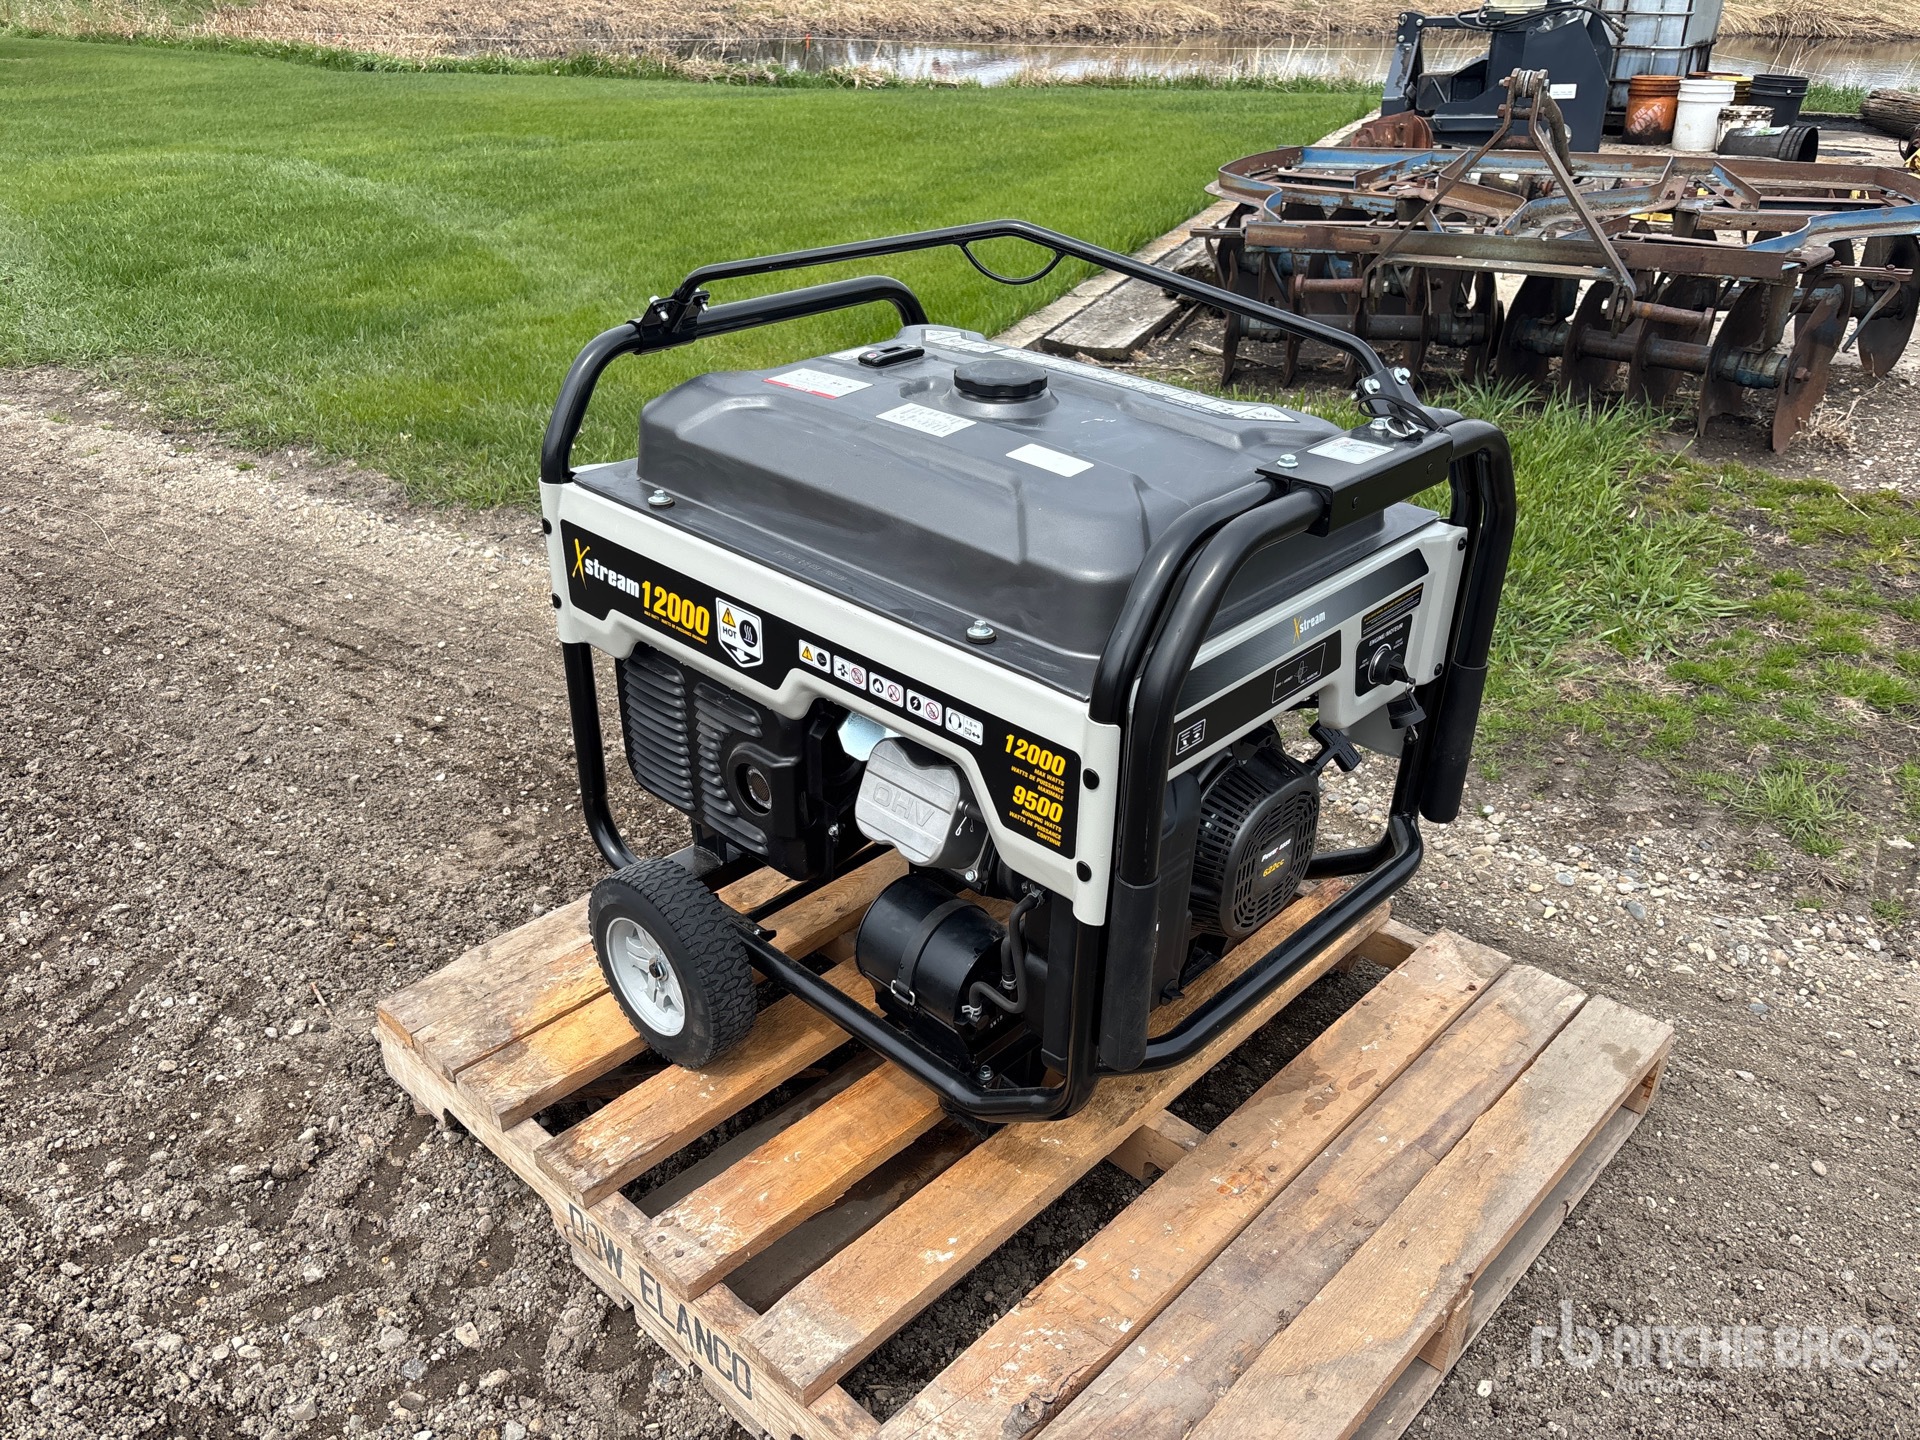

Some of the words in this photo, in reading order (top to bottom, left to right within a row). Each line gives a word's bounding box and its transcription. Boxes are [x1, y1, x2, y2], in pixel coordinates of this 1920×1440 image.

[572, 538, 640, 598] Xstream
[642, 580, 710, 637] 12000
[722, 626, 737, 639] HOT
[1293, 612, 1325, 644] Xstream
[1005, 734, 1066, 777] 12000
[1011, 765, 1028, 778] WATTS
[1029, 774, 1036, 782] DE
[1036, 777, 1064, 795] PUISSANCE
[1034, 768, 1046, 778] MAX
[1046, 773, 1065, 787] WATTS
[1037, 784, 1064, 802] MAXIMALE
[873, 782, 935, 828] OHV
[1012, 785, 1064, 823] 9500
[1009, 811, 1026, 823] WATTS
[1027, 819, 1033, 827] DE
[1034, 823, 1062, 841] PUISSANCE
[1021, 809, 1043, 824] RUNNING
[1044, 820, 1062, 833] WATTS
[1036, 830, 1061, 847] CONTINUE
[569, 1202, 623, 1280] DOW
[639, 1266, 752, 1400] ELANCO
